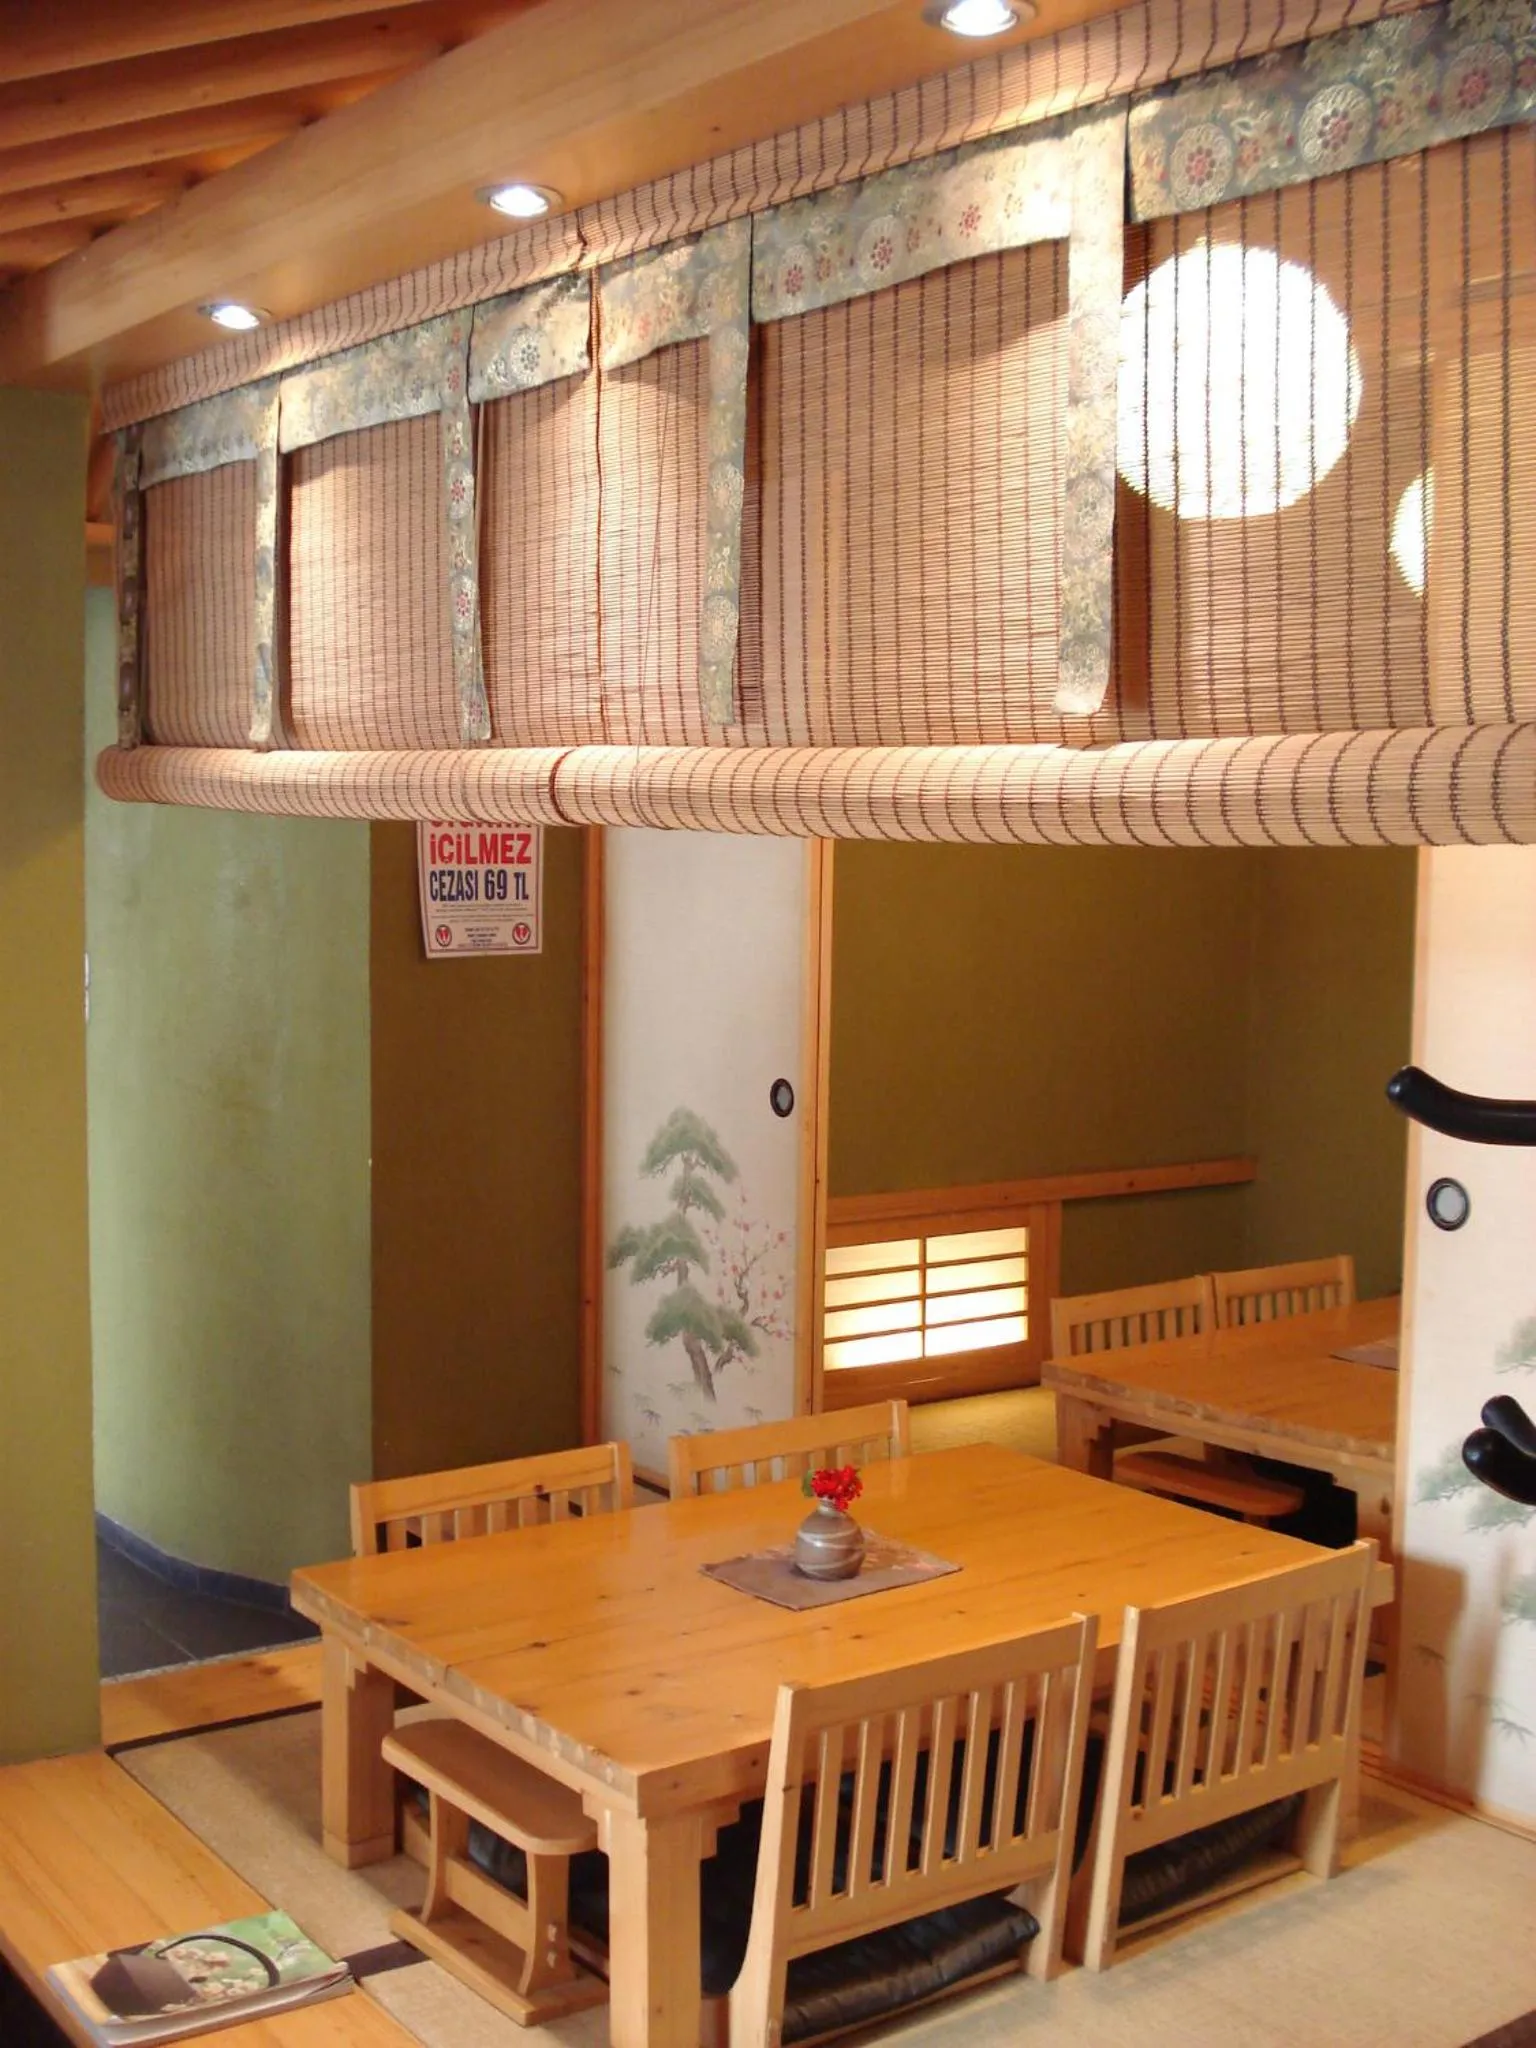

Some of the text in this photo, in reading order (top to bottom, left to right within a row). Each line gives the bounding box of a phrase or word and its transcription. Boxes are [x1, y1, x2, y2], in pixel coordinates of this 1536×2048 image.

[429, 869, 529, 902] CEZASI 69 TL
